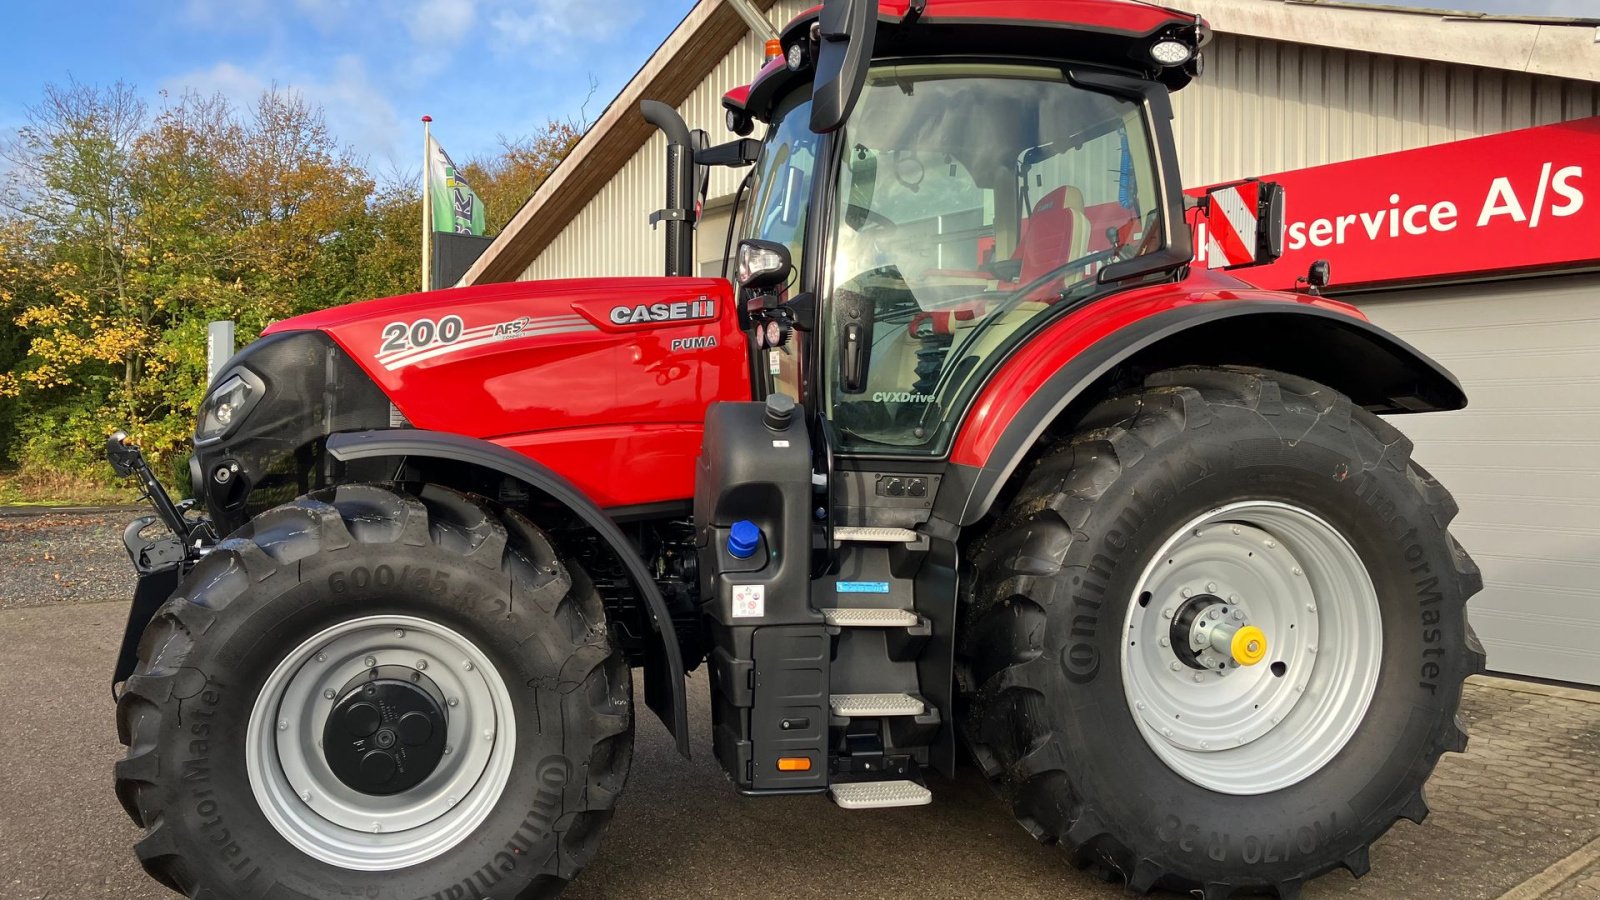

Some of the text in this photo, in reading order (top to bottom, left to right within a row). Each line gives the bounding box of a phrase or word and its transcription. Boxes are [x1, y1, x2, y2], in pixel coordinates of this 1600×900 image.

[1283, 162, 1584, 250] service A/S
[610, 303, 688, 325] CASE
[381, 314, 464, 356] 200
[671, 336, 717, 351] PUMA
[872, 391, 936, 403] CVXDrive
